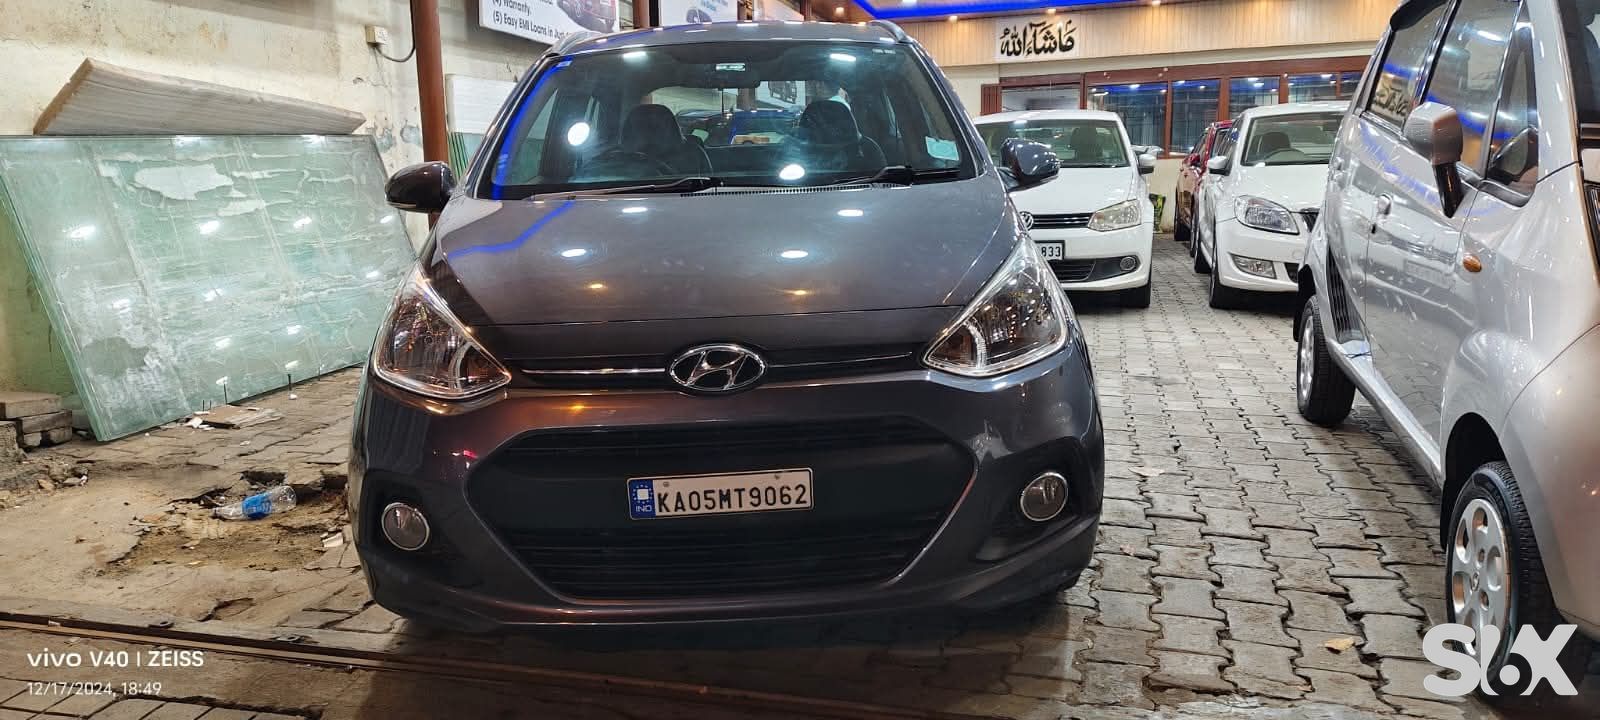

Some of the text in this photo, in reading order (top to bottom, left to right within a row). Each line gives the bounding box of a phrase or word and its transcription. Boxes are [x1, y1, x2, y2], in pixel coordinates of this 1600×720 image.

[493, 10, 502, 24] (5)
[504, 13, 517, 29] Easy
[519, 18, 529, 31] EMI
[530, 21, 547, 35] Loans
[548, 26, 553, 38] in
[657, 484, 807, 513] KA05MT9062
